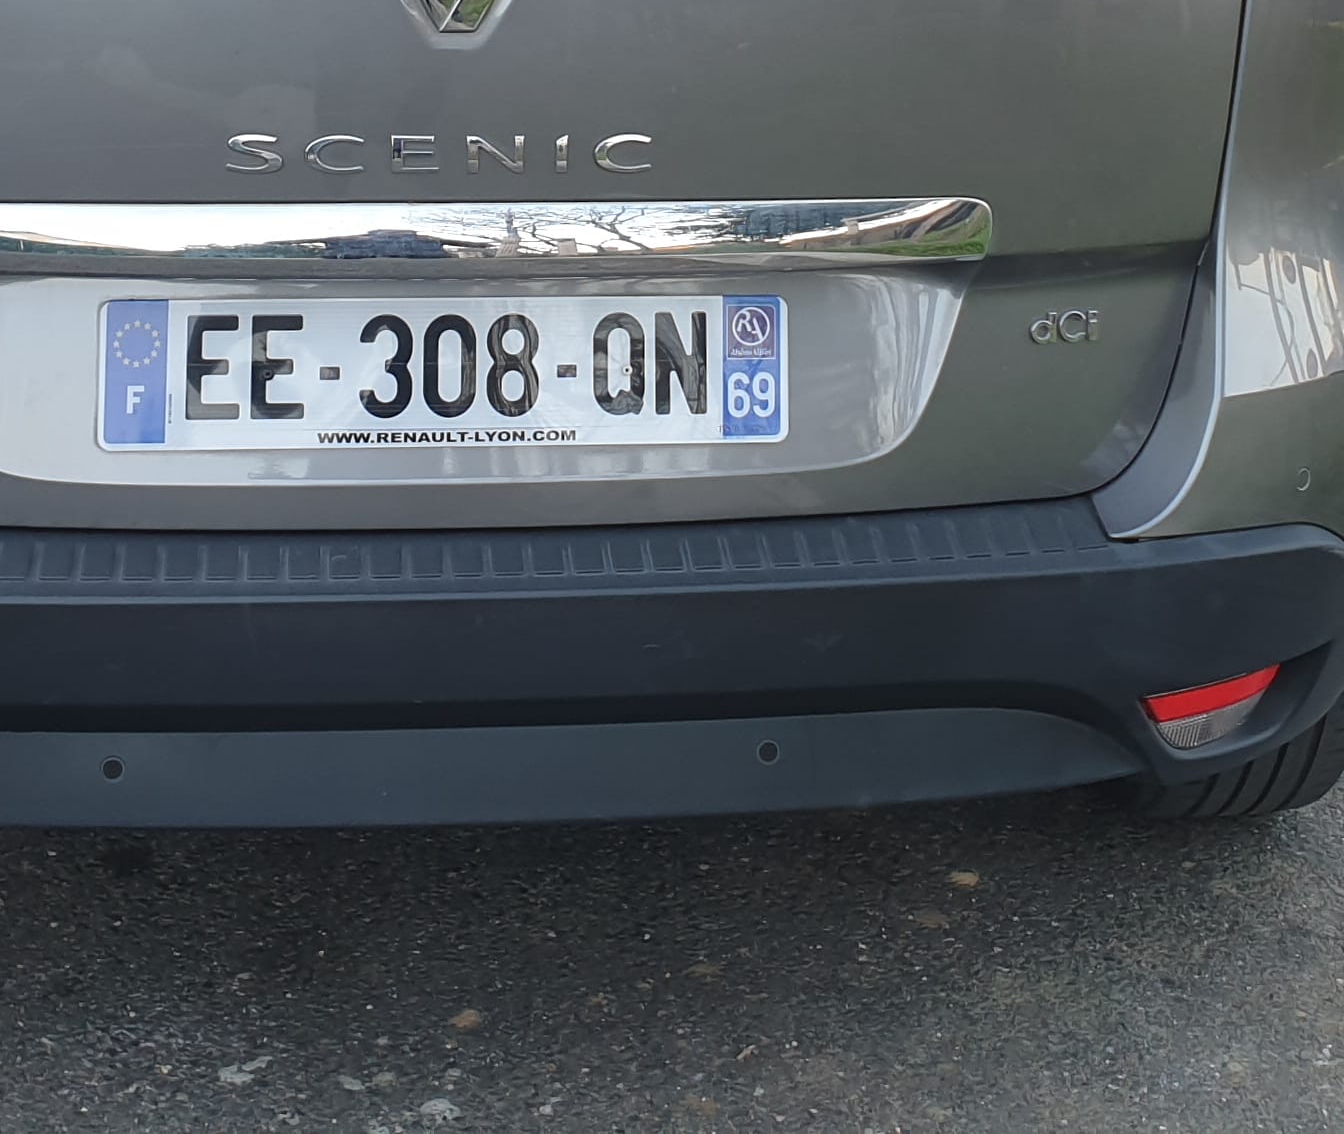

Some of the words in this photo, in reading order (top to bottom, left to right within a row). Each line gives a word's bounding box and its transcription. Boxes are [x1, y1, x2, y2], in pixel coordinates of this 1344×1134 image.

[224, 132, 653, 174] SCENIC
[1029, 309, 1100, 344] dCi
[184, 311, 707, 421] EE-308-QN
[125, 385, 145, 415] F
[727, 371, 776, 418] 69
[317, 428, 577, 445] WWW.RENAULT-LYON.COM
